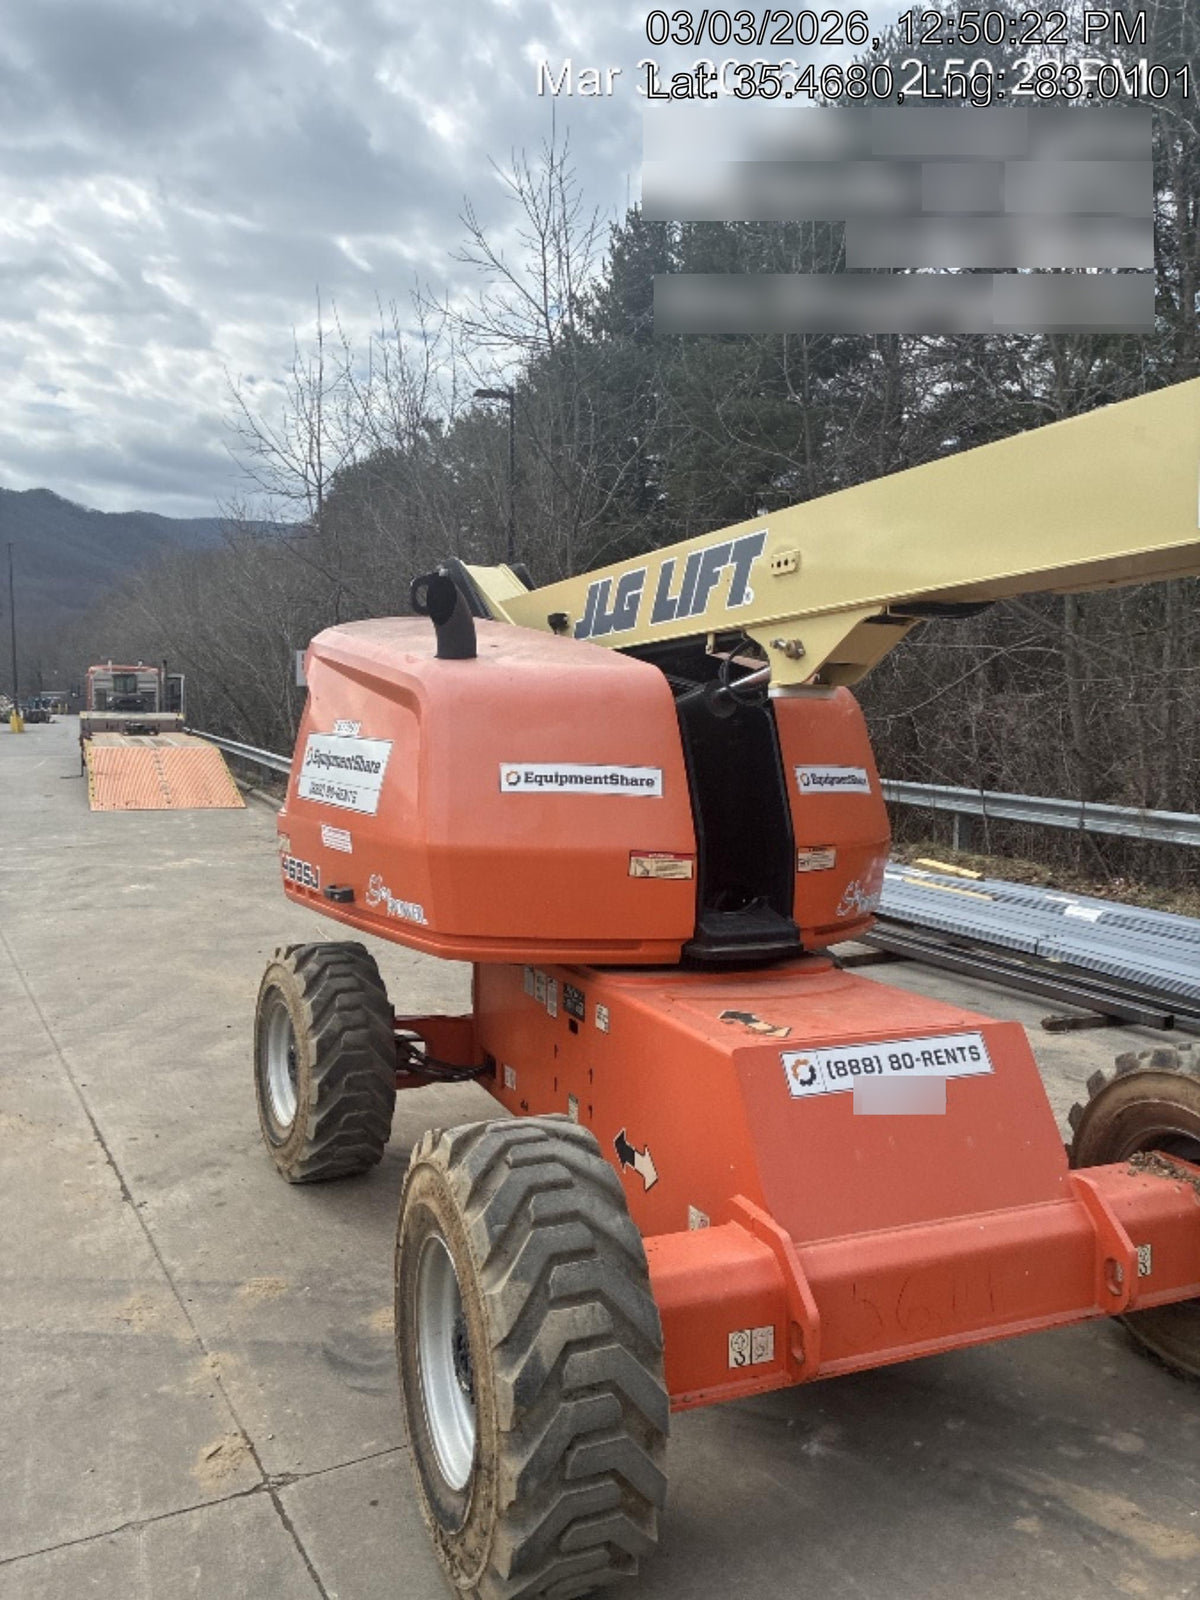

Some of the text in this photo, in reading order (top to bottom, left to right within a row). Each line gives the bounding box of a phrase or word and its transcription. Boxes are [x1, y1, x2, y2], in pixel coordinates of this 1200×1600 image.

[573, 528, 768, 641] JLG LIFT
[524, 770, 656, 788] EquipmentShare
[825, 1044, 982, 1079] (888) 80-RENTS
